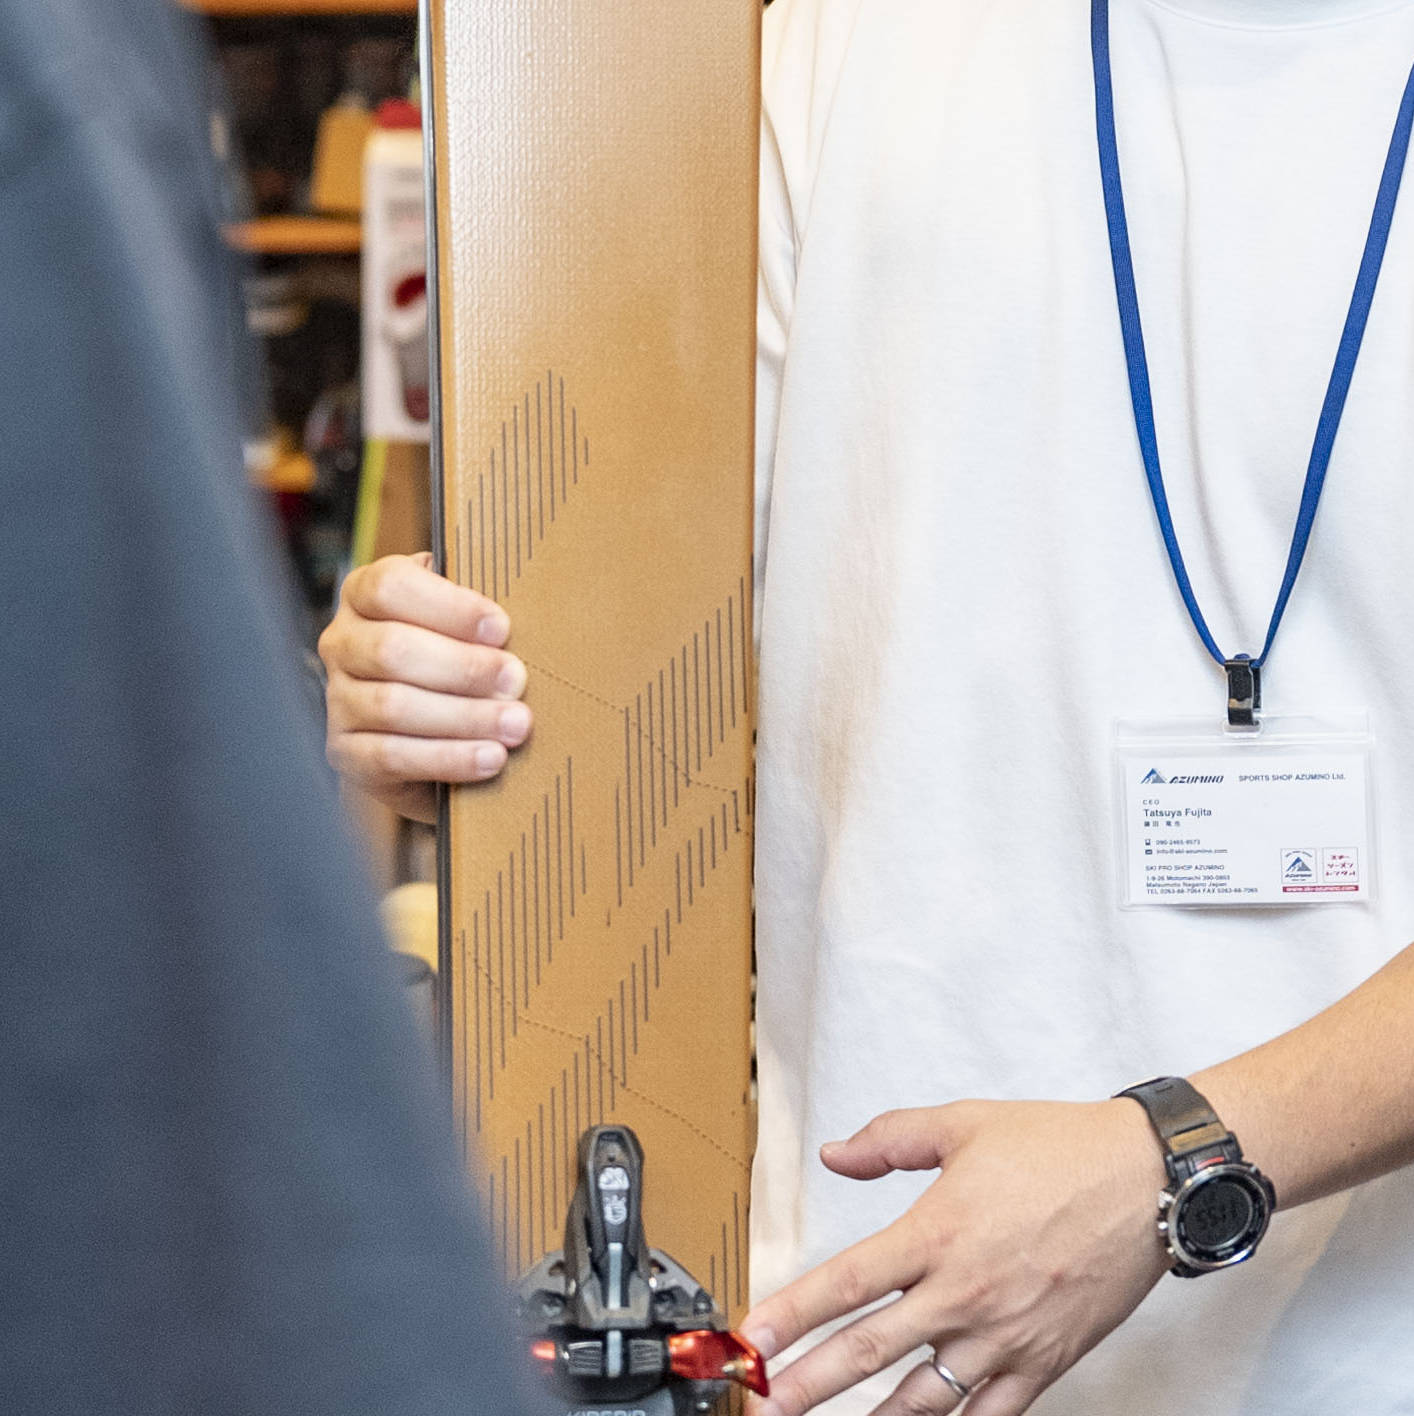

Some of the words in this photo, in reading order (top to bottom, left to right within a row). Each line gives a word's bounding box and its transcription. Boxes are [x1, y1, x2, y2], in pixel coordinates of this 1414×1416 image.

[1169, 775, 1224, 784] AZUMINO
[1238, 774, 1270, 782] SPORTS
[1295, 773, 1330, 781] AZUMINO
[1143, 808, 1182, 818] Tatsuya
[1185, 807, 1212, 818] Fujita
